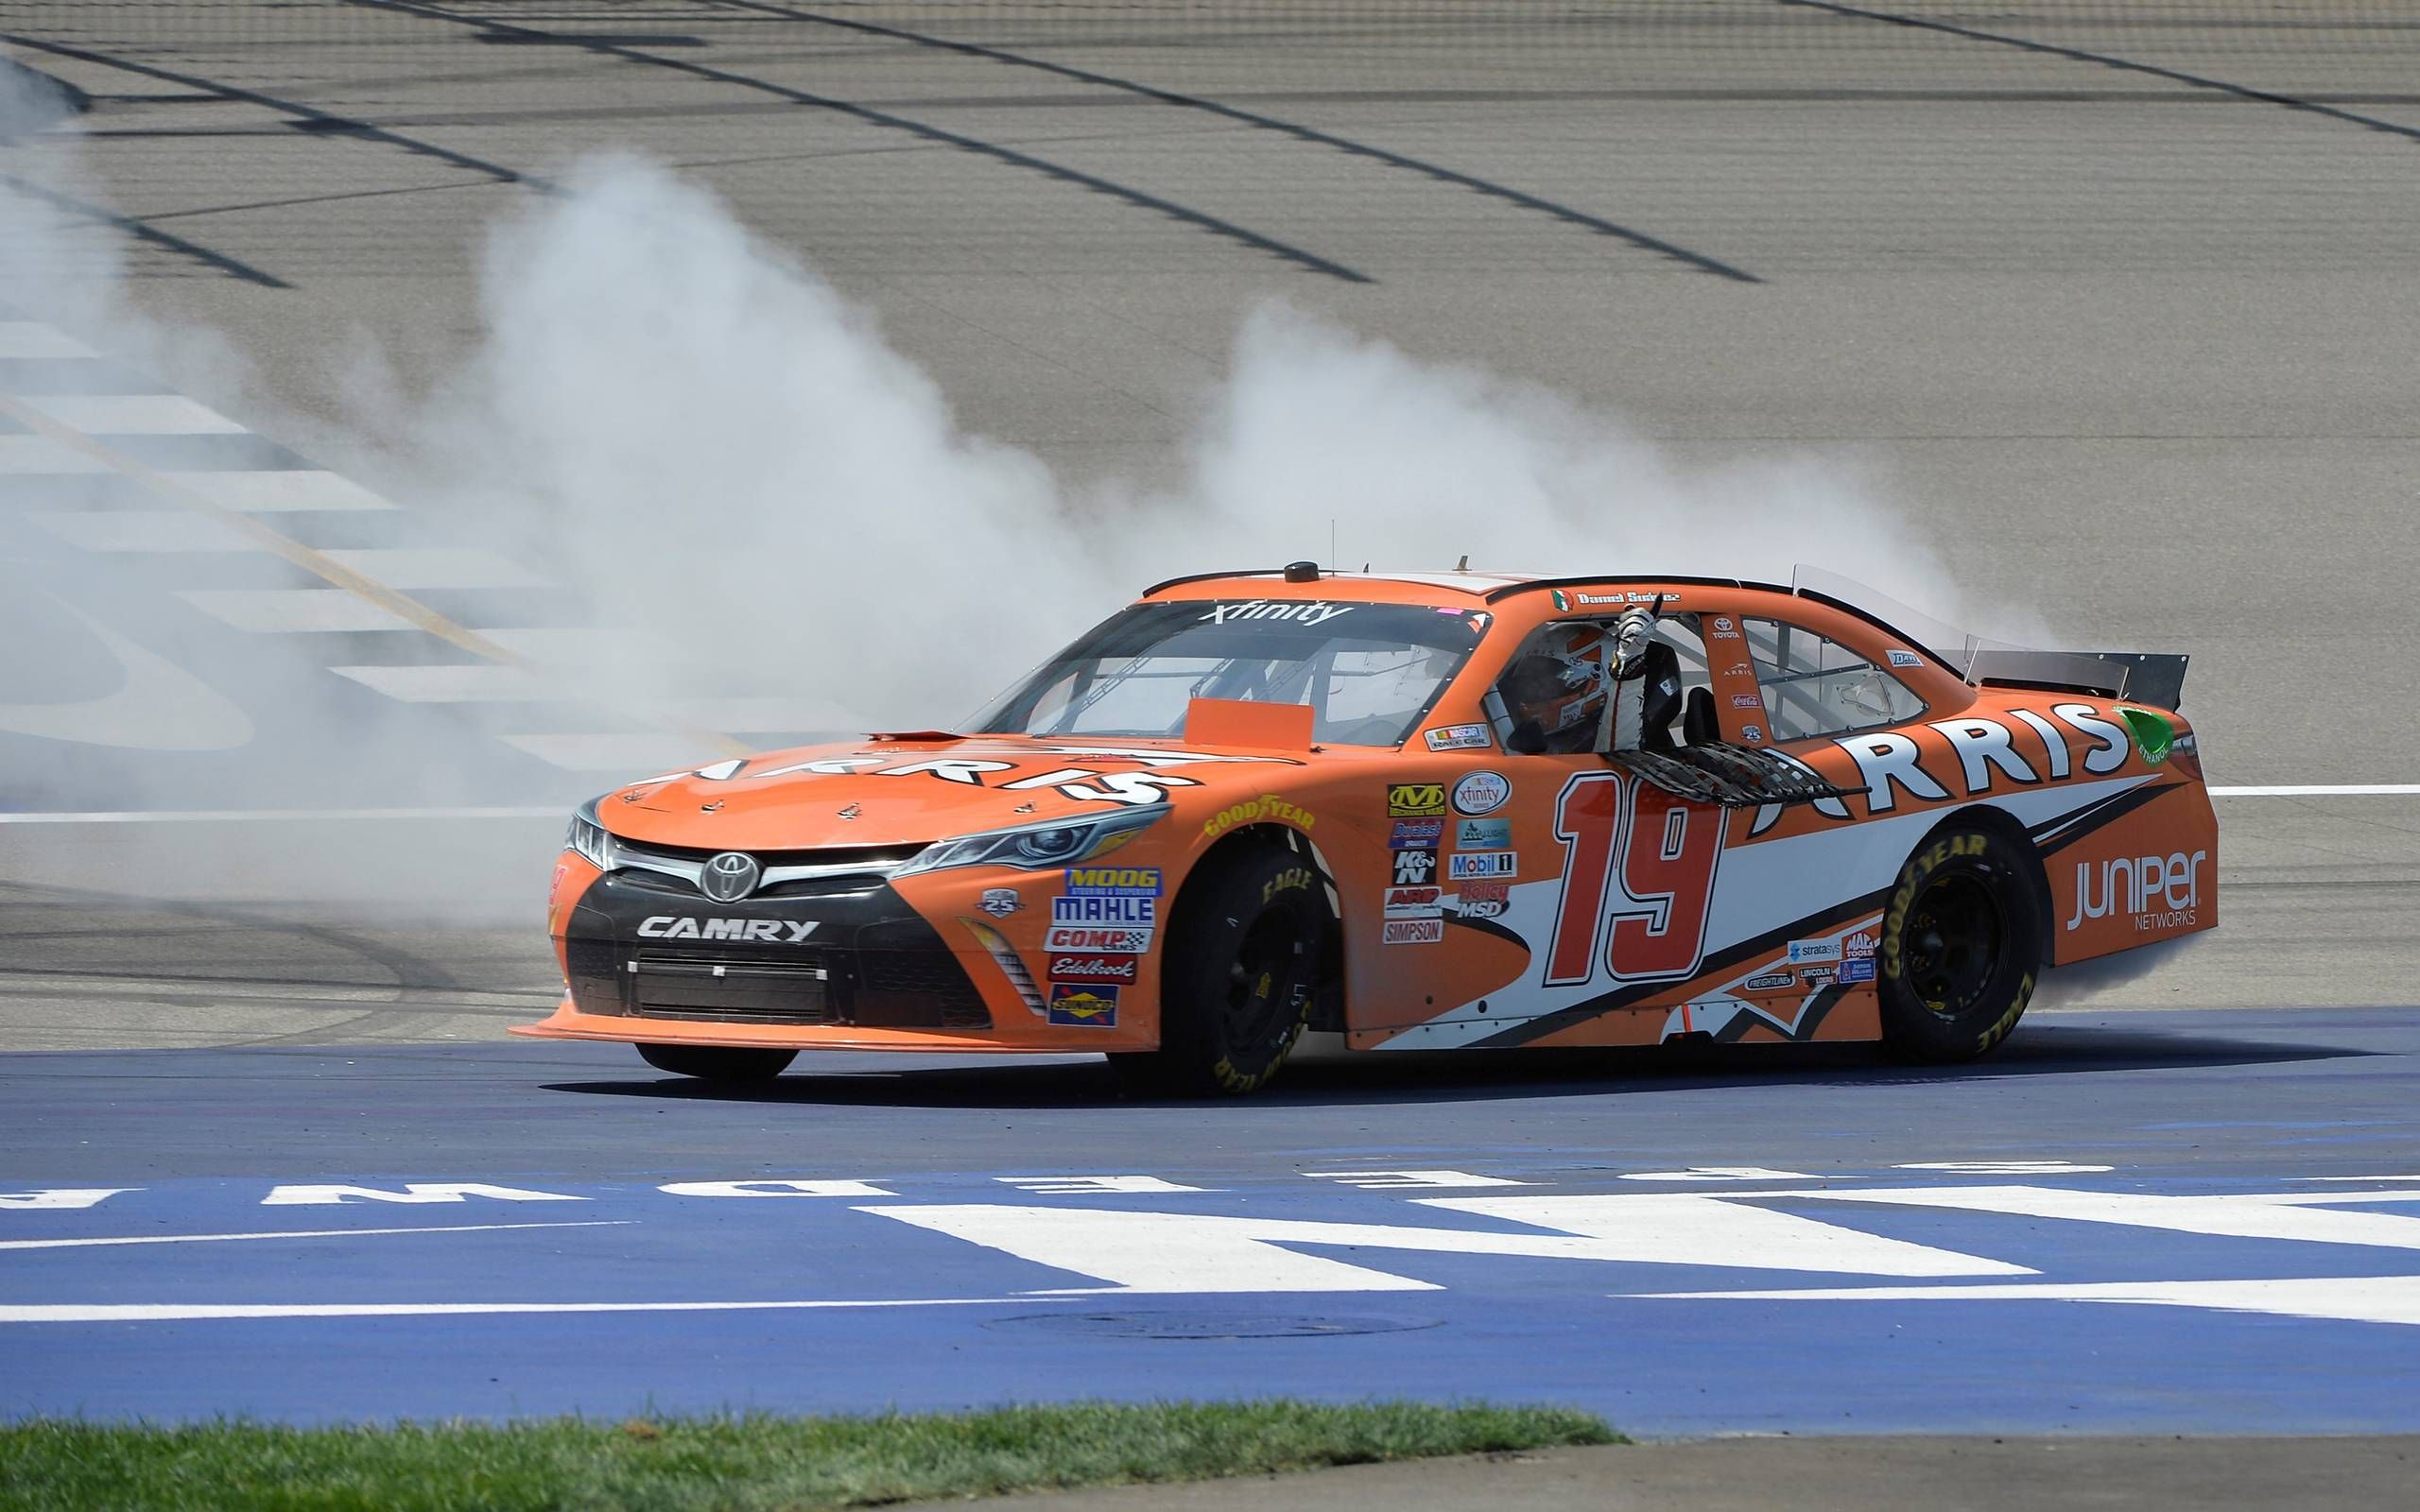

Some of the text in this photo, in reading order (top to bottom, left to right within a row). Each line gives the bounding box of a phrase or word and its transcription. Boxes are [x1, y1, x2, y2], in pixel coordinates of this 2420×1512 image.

[1197, 600, 1355, 627] xfinity
[2138, 743, 2169, 765] ETHANOL
[1460, 786, 1499, 804] xfinity
[1204, 795, 1315, 836] GOODYEAR
[1454, 854, 1495, 873] Mobil
[1069, 870, 1158, 886] MOOG
[1263, 868, 1312, 904] EAGLE
[1544, 770, 1727, 988] 19
[984, 899, 1015, 912] 25
[1056, 899, 1153, 920] MAHLE
[1457, 902, 1501, 919] MSD
[1884, 834, 1987, 979] GOODYEAR
[636, 916, 821, 942] CAMRY
[2135, 910, 2196, 931] NETWORKS
[1052, 930, 1126, 946] COMP
[1386, 922, 1440, 941] SIMPSON
[1802, 943, 1841, 956] stratasys
[1051, 958, 1134, 977] Edelbrock
[1800, 968, 1831, 977] LINCOLN
